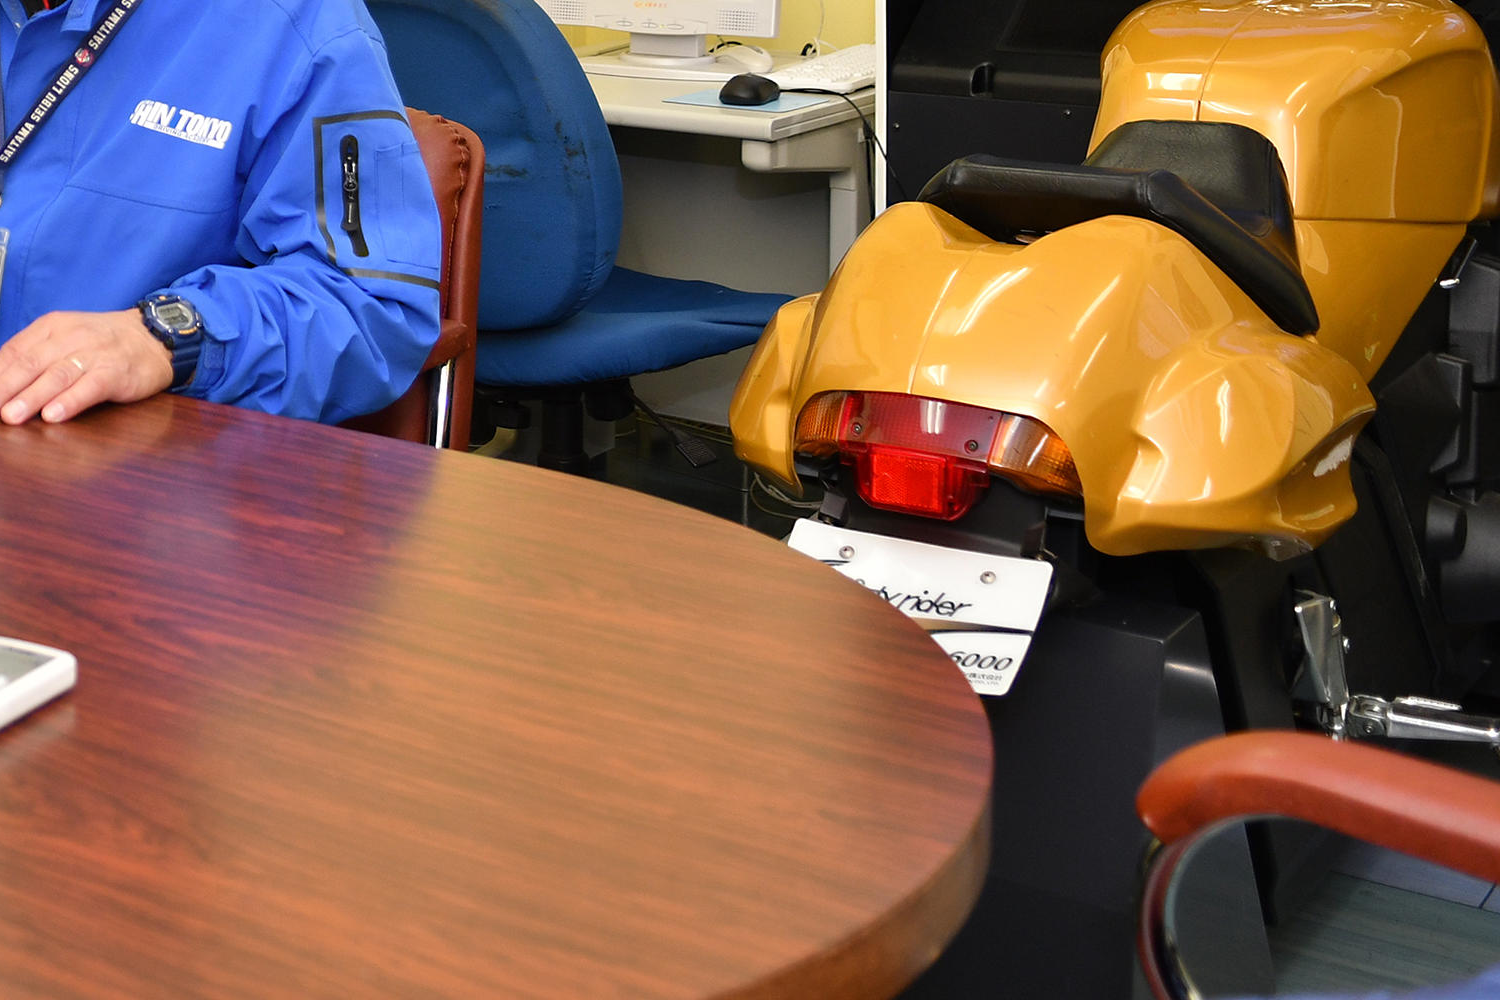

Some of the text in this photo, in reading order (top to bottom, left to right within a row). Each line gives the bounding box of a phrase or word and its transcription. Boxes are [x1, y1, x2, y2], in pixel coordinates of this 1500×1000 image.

[88, 7, 126, 50] SAITAMA
[0, 64, 79, 163] SAITAMA SEIBU LIONS
[176, 109, 233, 143] TOKYO
[897, 590, 973, 617] rider
